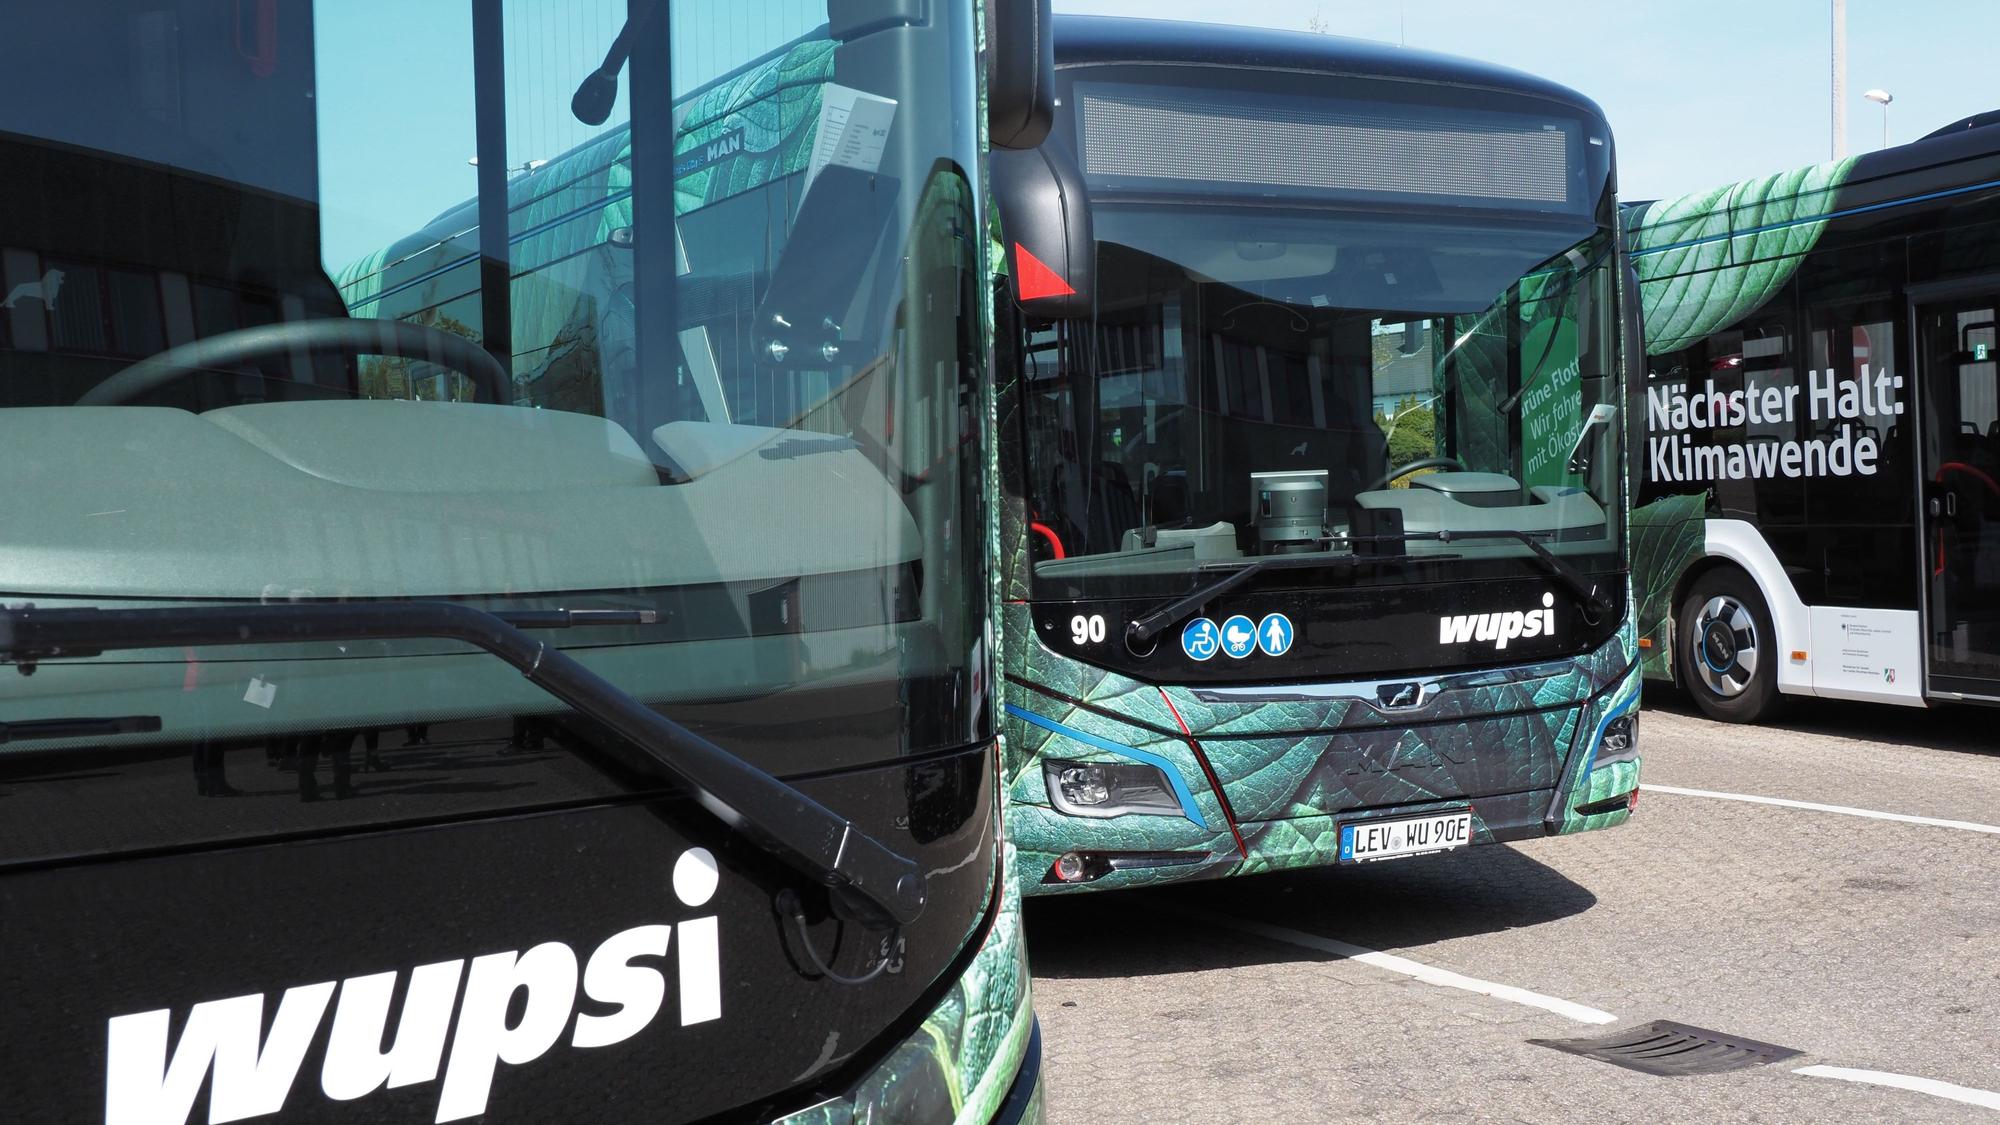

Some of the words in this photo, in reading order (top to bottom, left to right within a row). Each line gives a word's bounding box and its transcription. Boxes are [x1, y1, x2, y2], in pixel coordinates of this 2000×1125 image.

[707, 133, 740, 161] MAN
[1521, 383, 1552, 418] rüne
[1648, 378, 1799, 431] Nächster
[1809, 363, 1904, 420] Halt:
[1530, 412, 1551, 440] Wir
[1528, 446, 1548, 475] mit
[1650, 424, 1878, 482] Klimawende
[1070, 614, 1106, 645] 90
[1440, 592, 1555, 649] wupsi
[1355, 826, 1392, 854] LEV
[1406, 822, 1429, 847] WU
[1434, 818, 1468, 843] 90E
[105, 847, 722, 1125] wupsi
